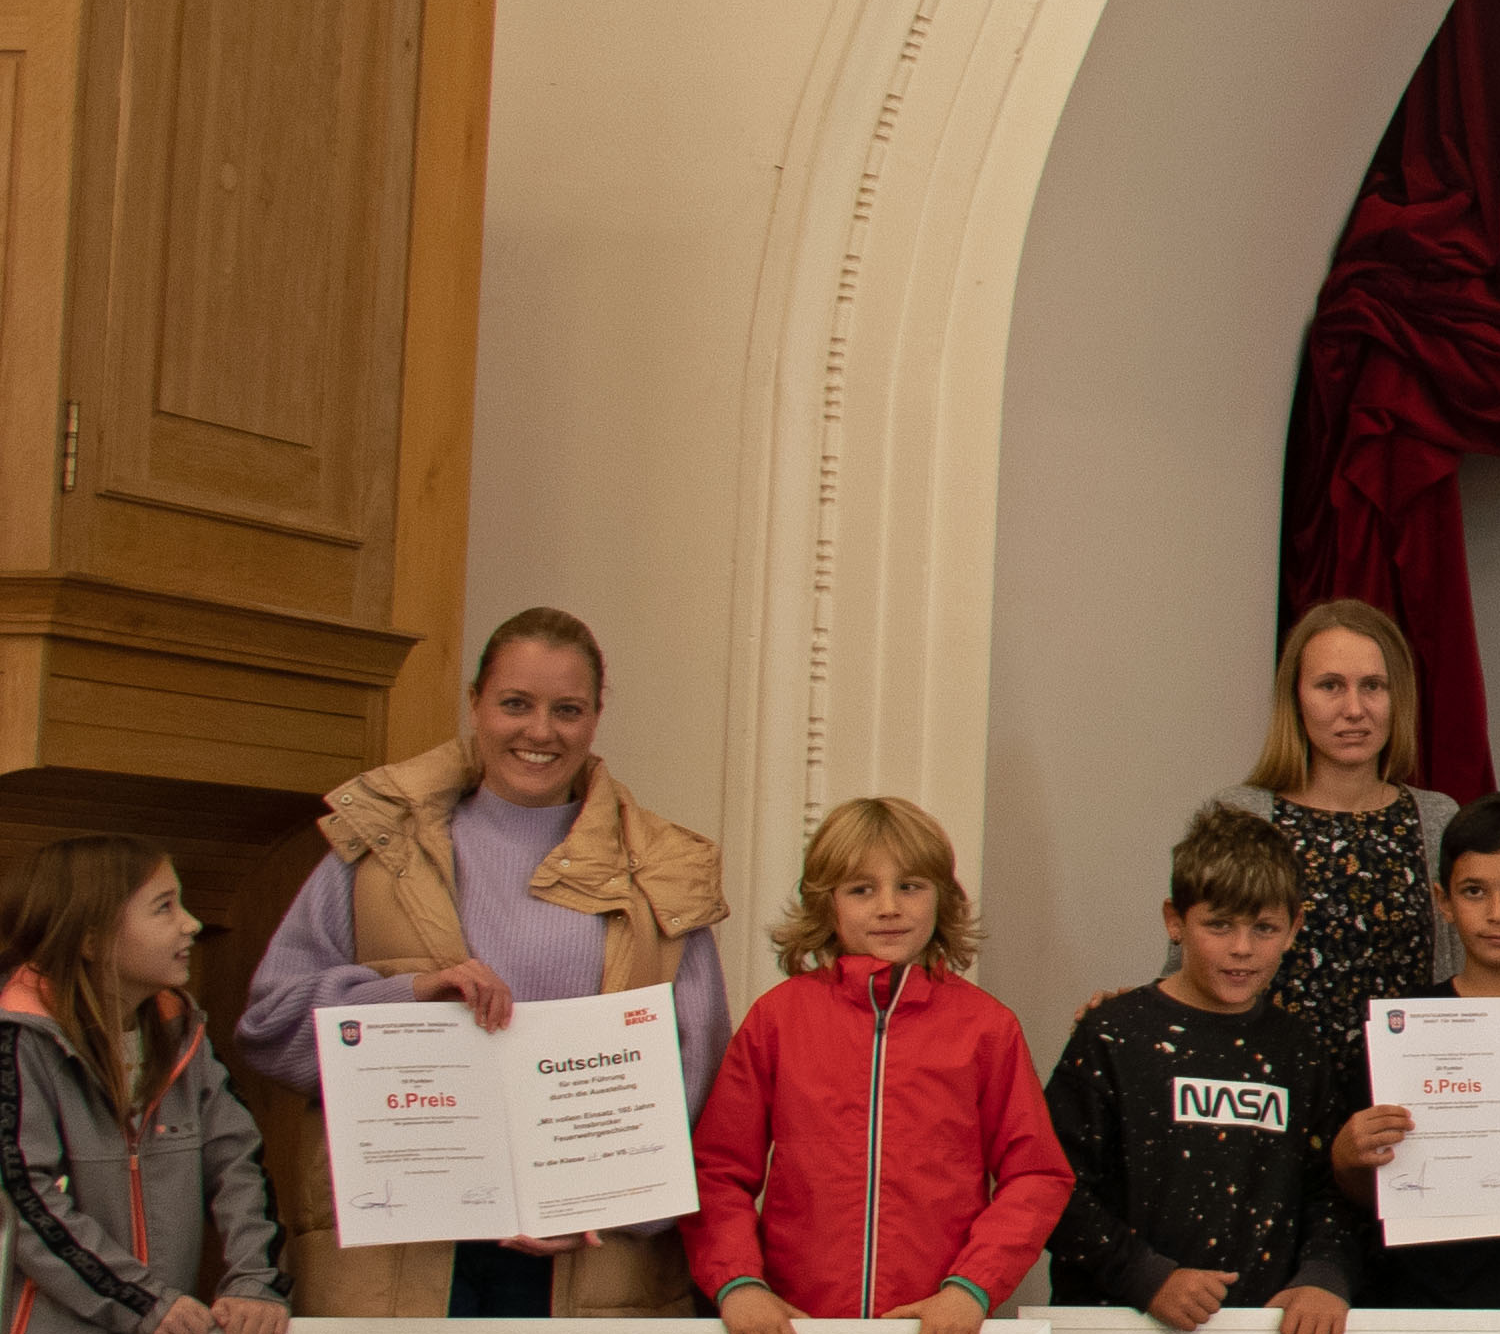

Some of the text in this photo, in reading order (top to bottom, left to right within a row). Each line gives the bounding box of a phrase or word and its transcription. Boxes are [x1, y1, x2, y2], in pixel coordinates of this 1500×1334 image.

[538, 1049, 641, 1074] Gutschein
[1424, 1079, 1482, 1094] 5.Preis
[387, 1092, 457, 1109] 6.Preis
[1181, 1083, 1284, 1126] NASA
